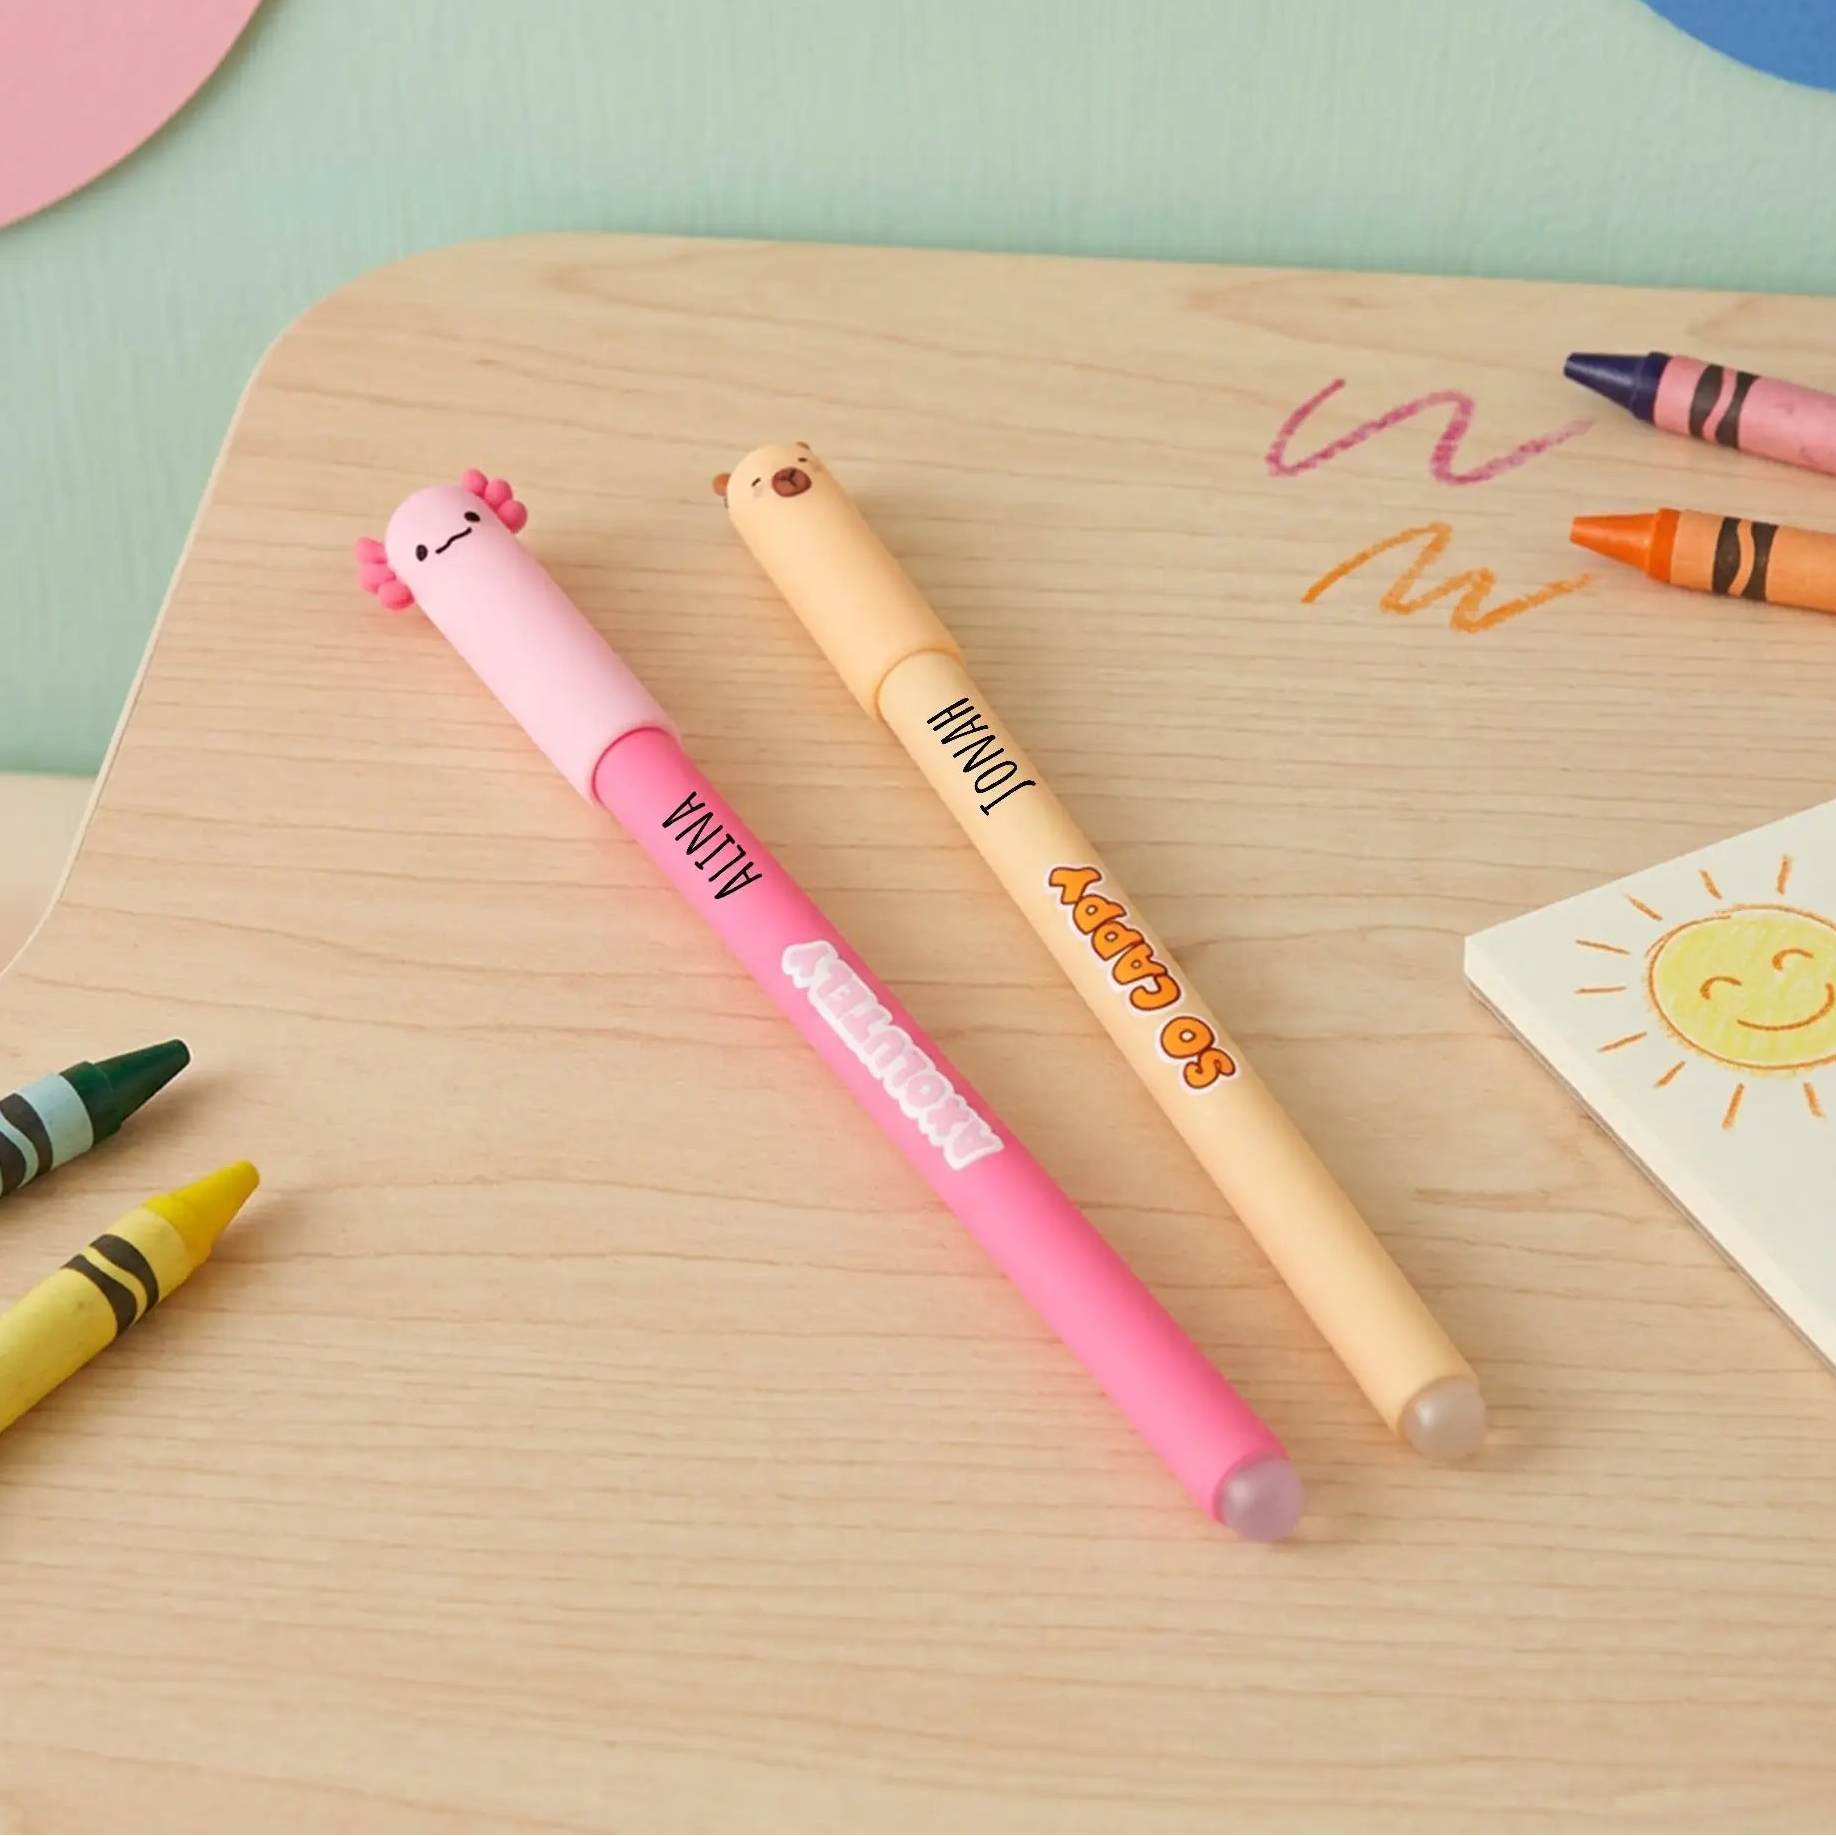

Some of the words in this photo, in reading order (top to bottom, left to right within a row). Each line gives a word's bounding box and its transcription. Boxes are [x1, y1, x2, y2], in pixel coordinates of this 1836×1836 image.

[927, 697, 1036, 816] JONAH
[661, 791, 762, 899] ALINA
[1047, 865, 1183, 1012] CAPPY
[782, 940, 1004, 1170] AXOLUTELY
[1158, 1015, 1237, 1091] SO
